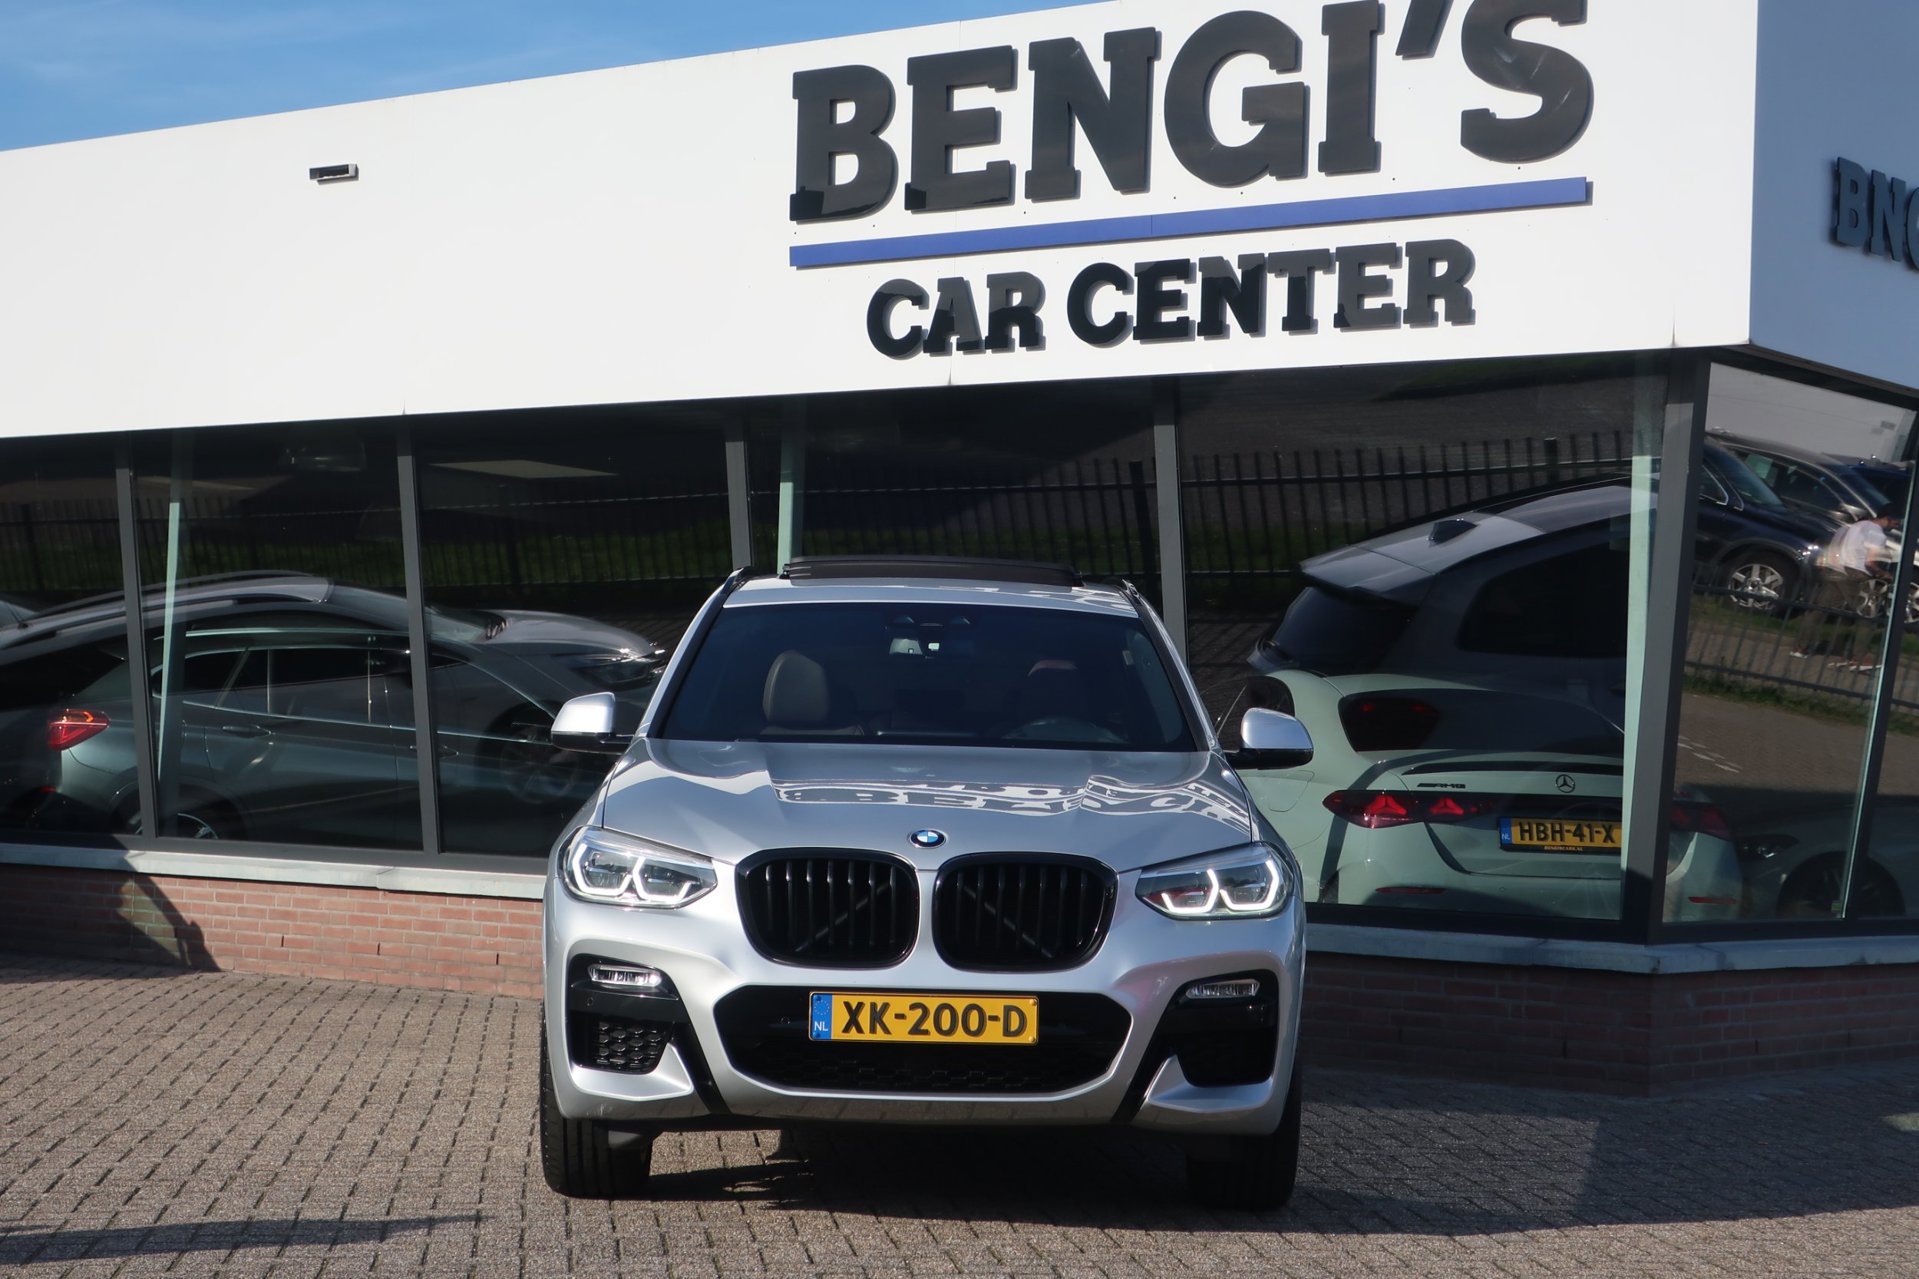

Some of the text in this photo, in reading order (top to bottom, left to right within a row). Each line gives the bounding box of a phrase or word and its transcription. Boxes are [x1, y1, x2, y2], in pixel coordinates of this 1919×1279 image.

[790, 0, 1594, 222] BENGI'S
[866, 239, 1476, 358] CAR CENTER
[1519, 822, 1616, 844] HBH-41-X
[814, 1021, 828, 1031] NL
[841, 1001, 1027, 1037] XK-200-D
